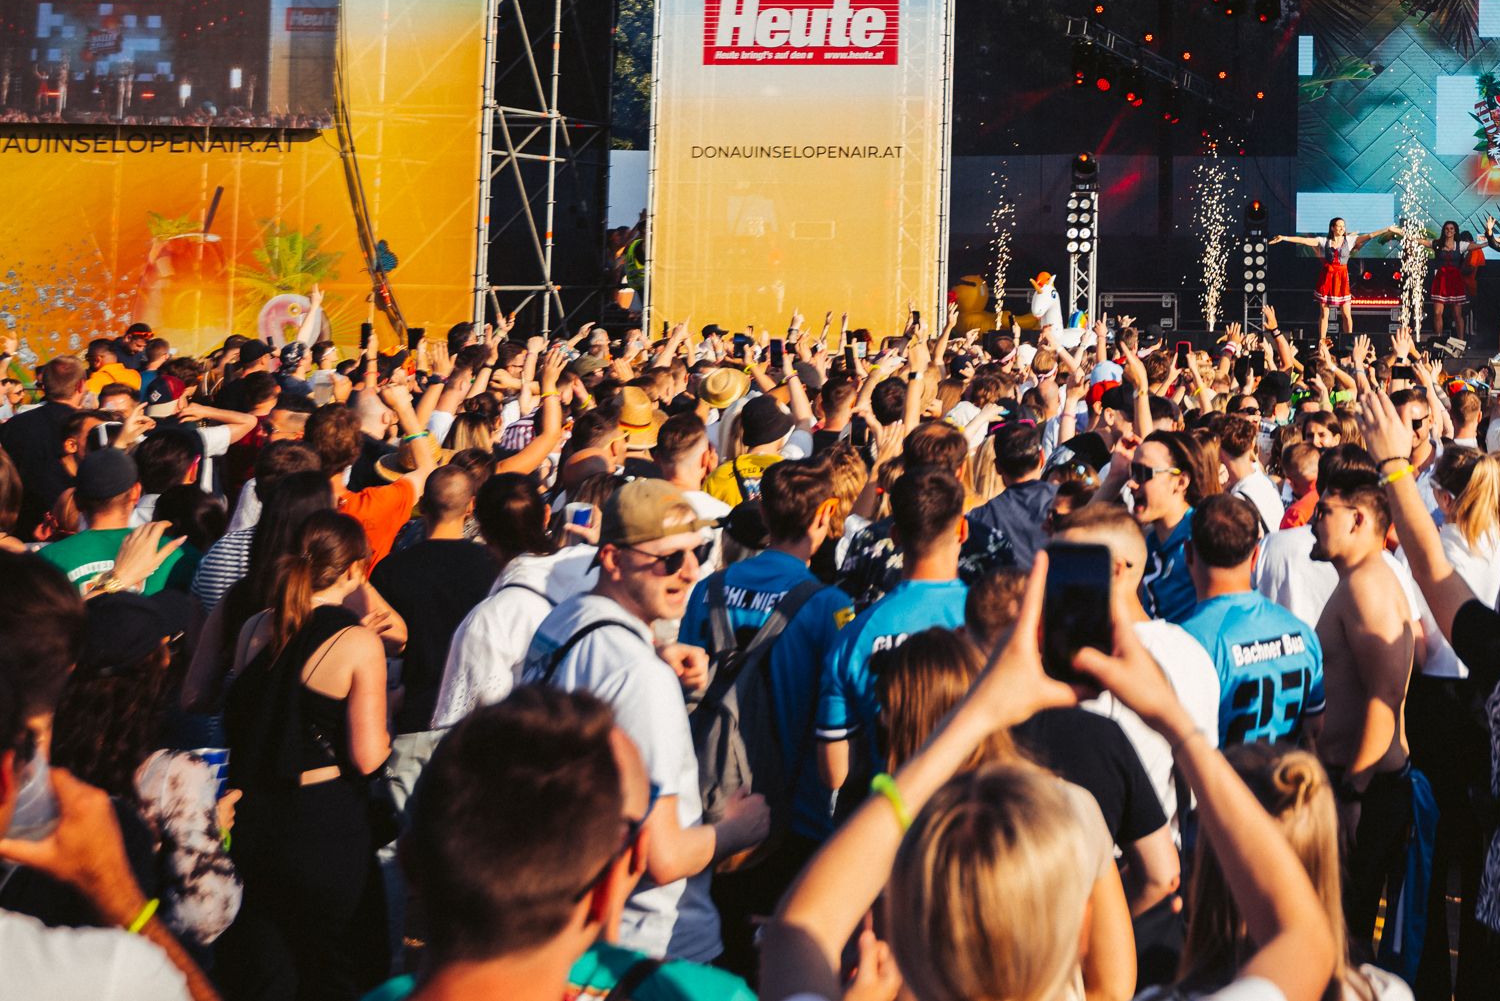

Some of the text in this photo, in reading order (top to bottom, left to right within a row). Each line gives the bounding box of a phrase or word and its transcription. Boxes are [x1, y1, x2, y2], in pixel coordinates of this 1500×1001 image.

[714, 50, 740, 60] Heute
[691, 146, 903, 159] DONAUINSELOPENAIR.AT
[1232, 633, 1305, 667] Bachner Bua
